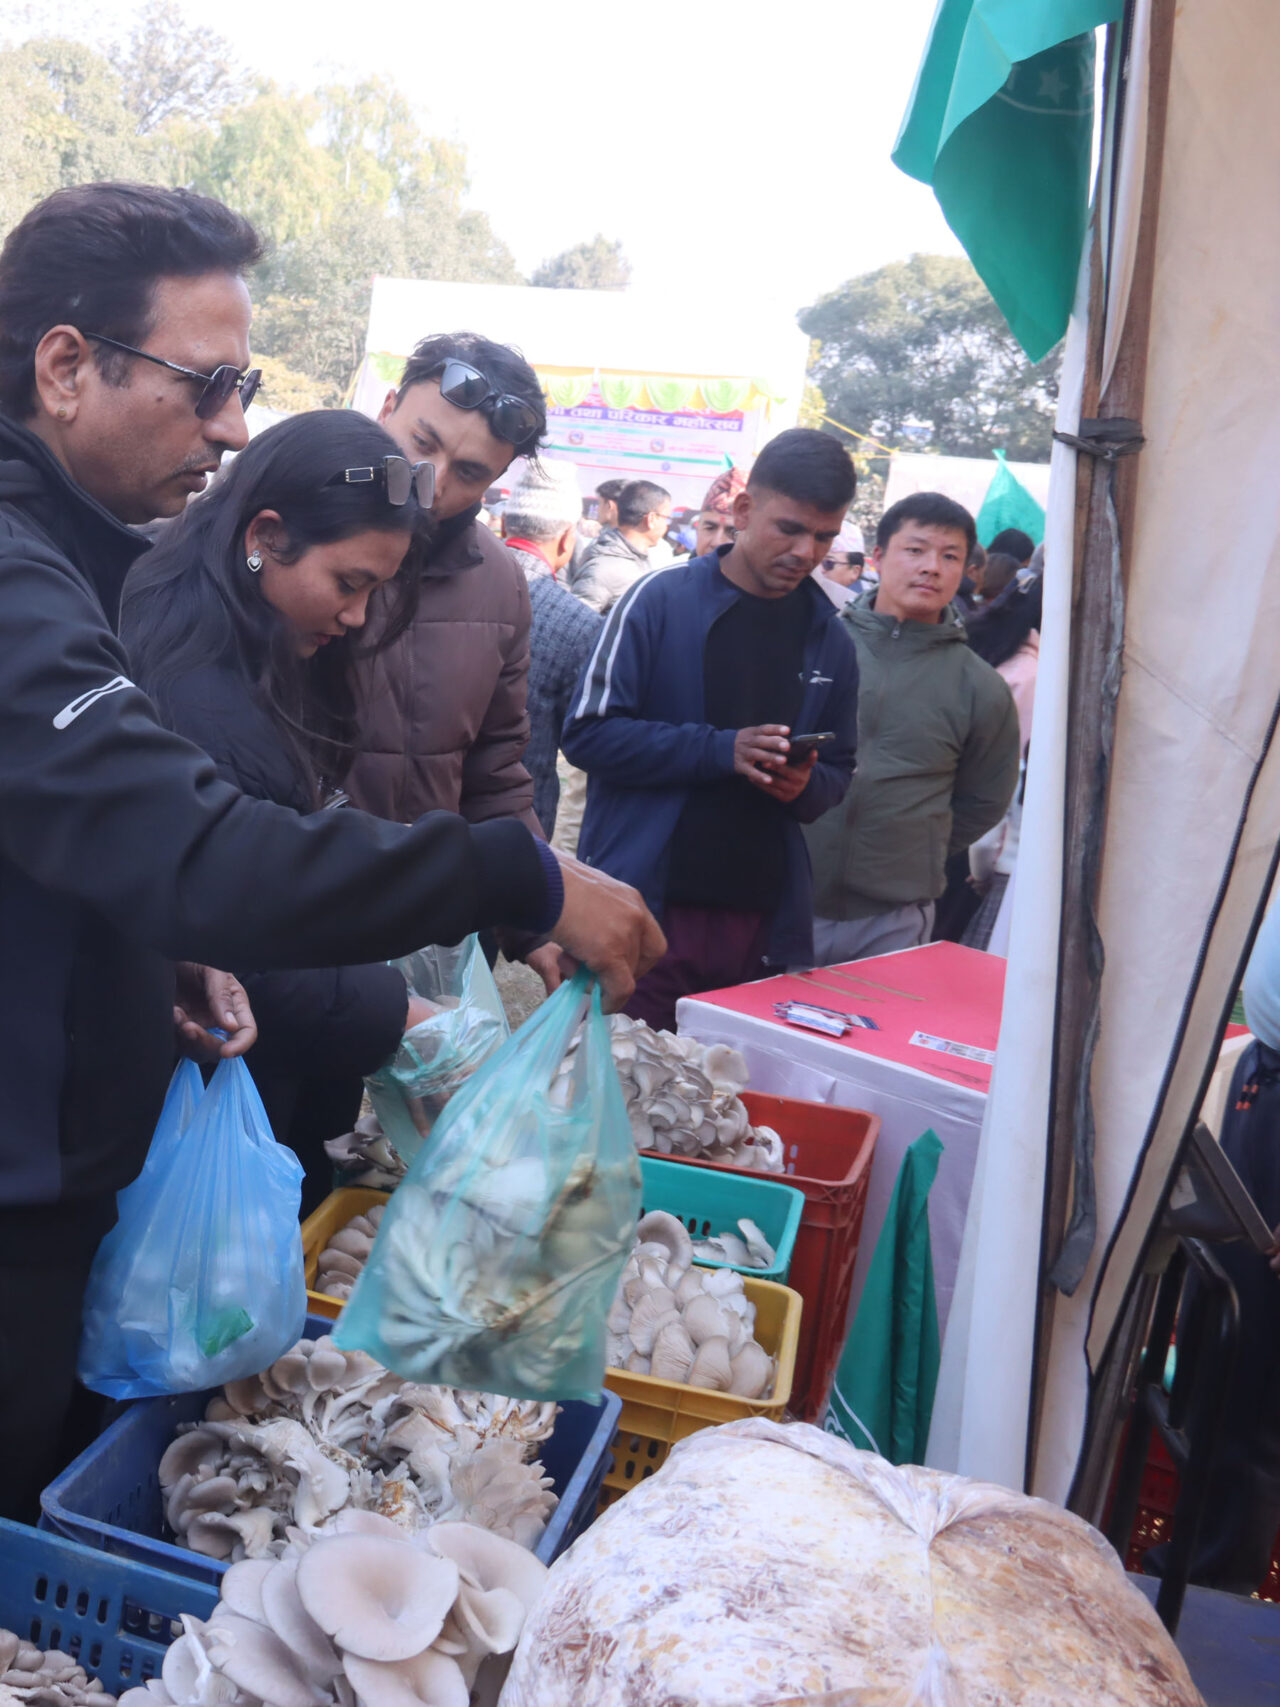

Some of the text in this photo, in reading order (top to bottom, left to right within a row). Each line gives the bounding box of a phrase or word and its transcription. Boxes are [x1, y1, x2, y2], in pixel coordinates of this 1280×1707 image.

[570, 406, 602, 420] तथा
[607, 407, 667, 426] परिकार
[673, 414, 742, 432] महोत्सव
